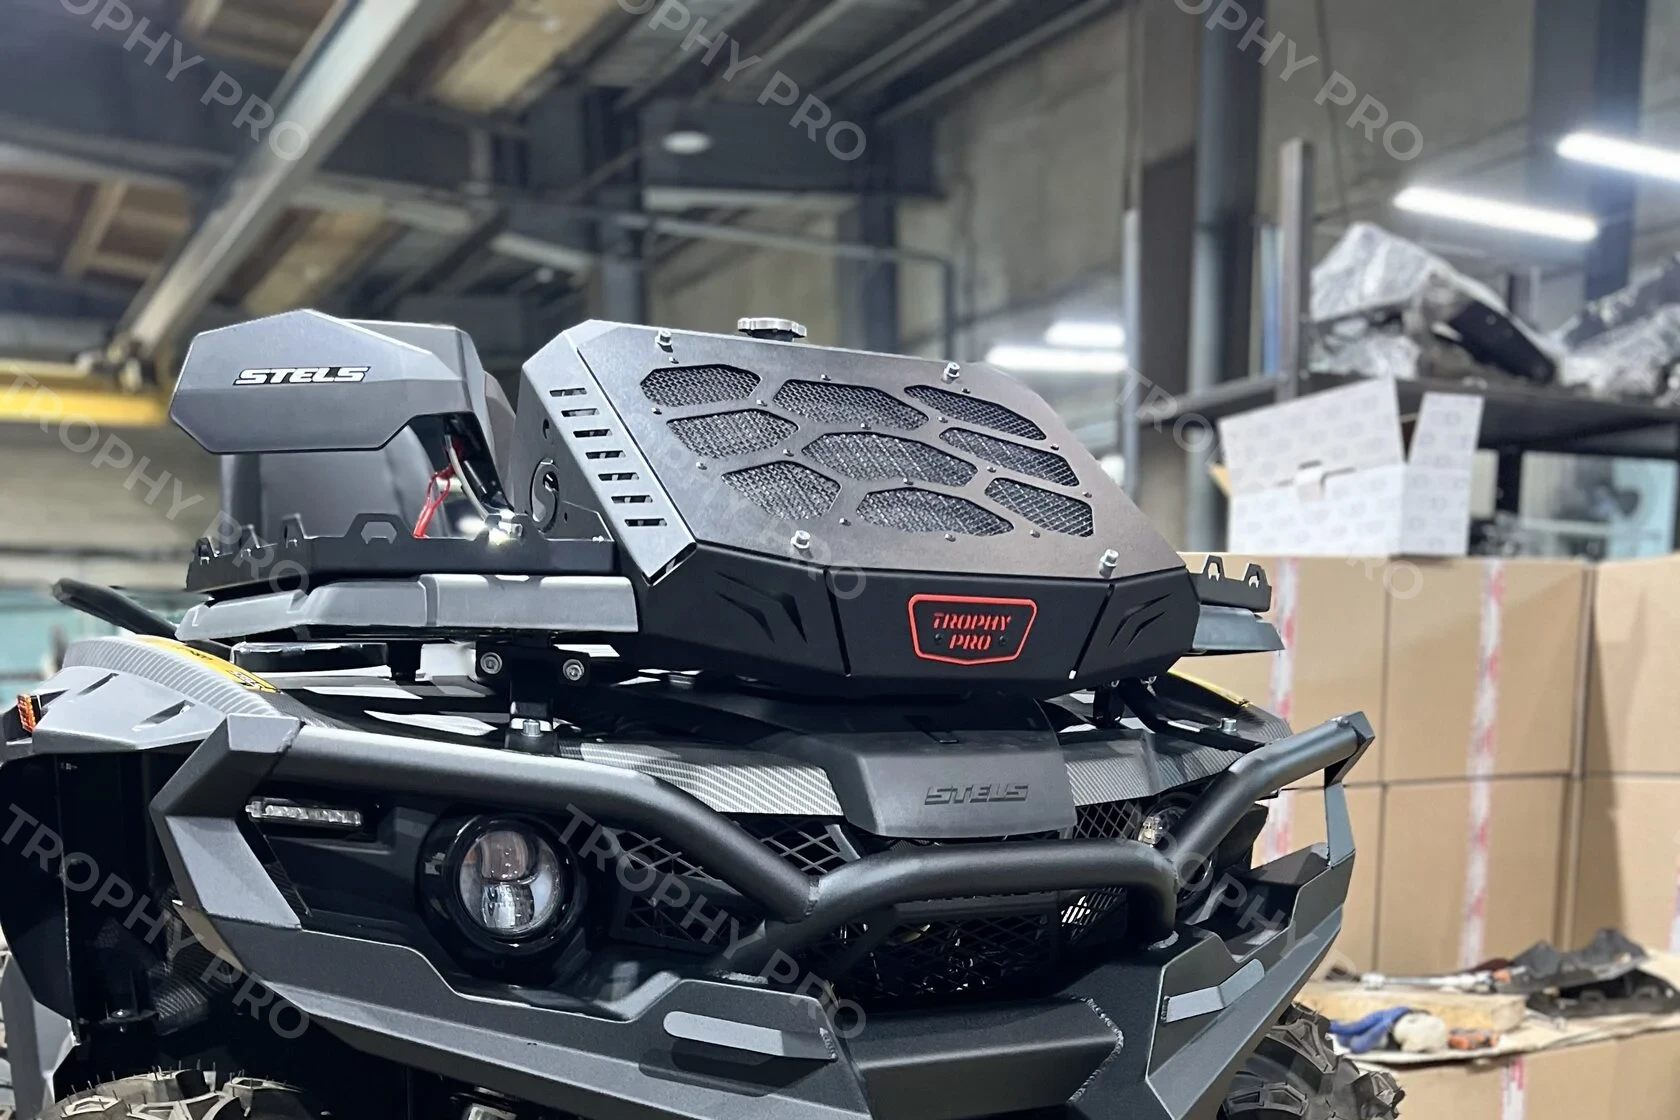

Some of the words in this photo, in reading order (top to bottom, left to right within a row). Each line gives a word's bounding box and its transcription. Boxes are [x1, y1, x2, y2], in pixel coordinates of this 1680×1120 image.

[233, 366, 371, 386] STELS
[932, 611, 1012, 631] TROPHY
[949, 633, 993, 651] PRO
[924, 784, 1030, 806] STELS
